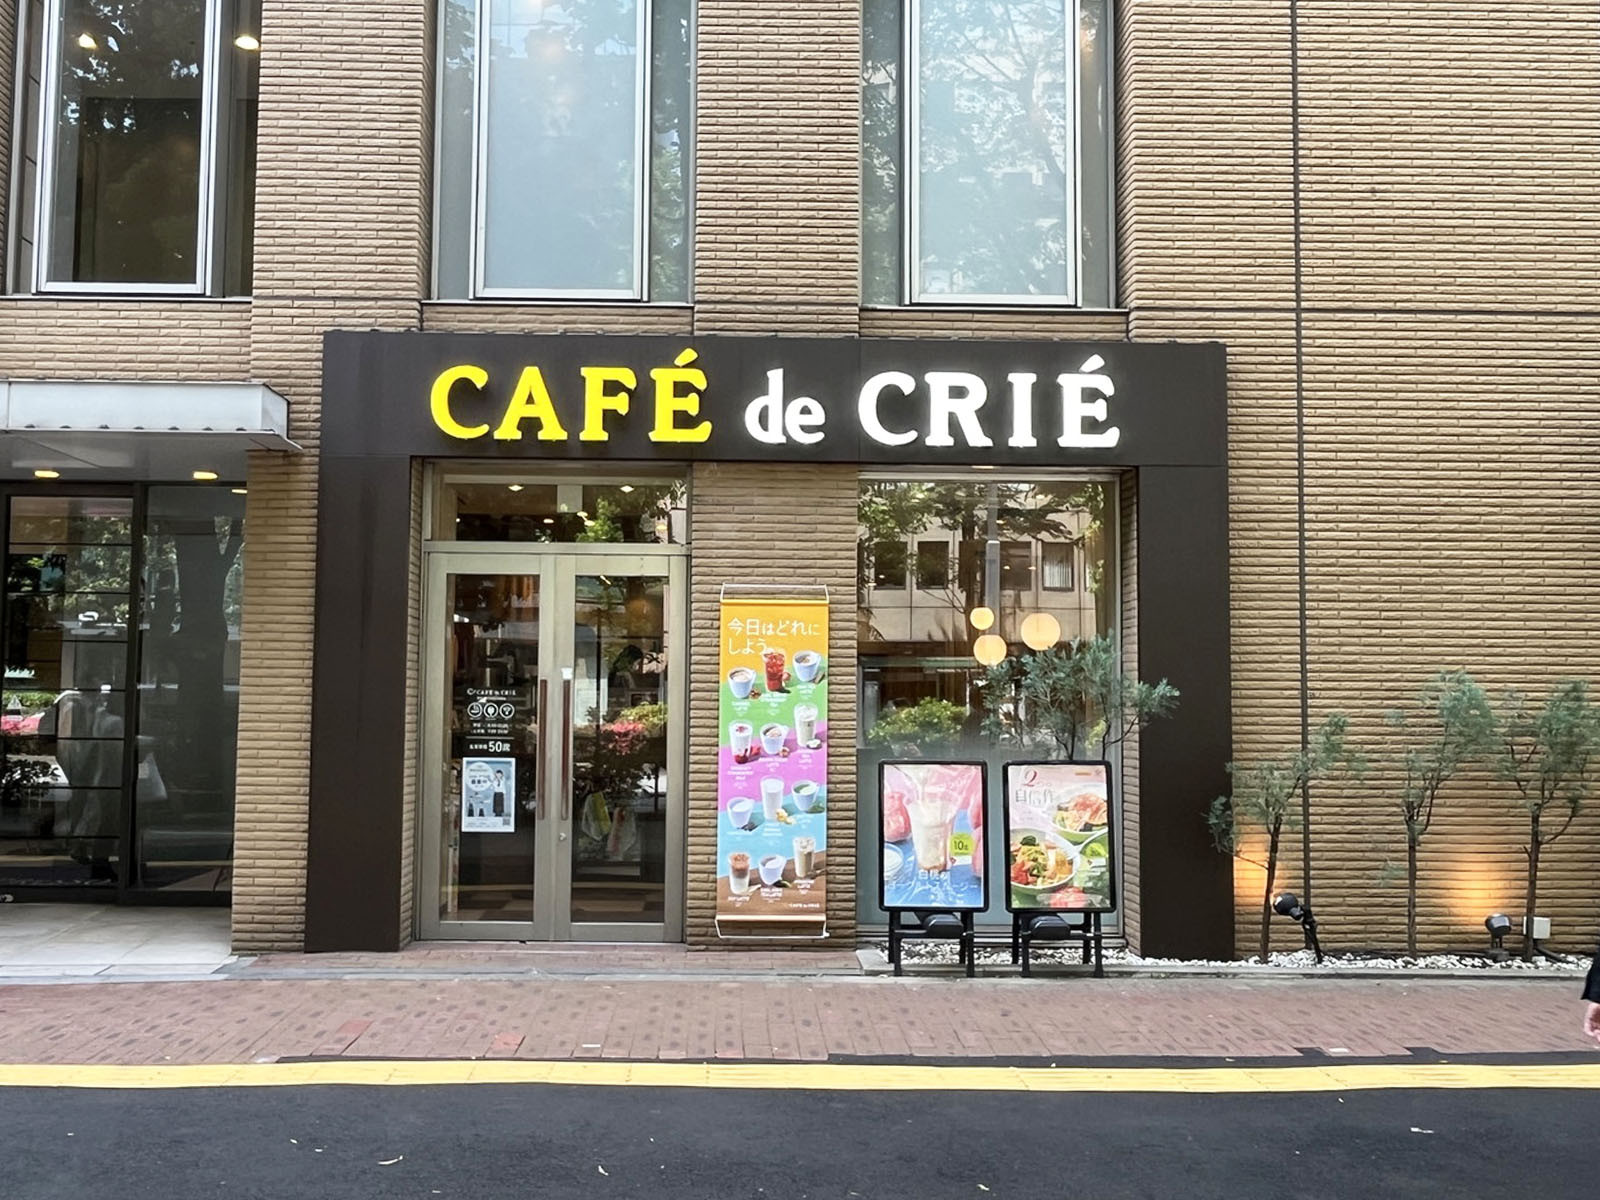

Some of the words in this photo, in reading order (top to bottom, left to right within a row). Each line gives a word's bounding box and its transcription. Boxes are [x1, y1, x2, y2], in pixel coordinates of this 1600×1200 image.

[430, 347, 712, 442] CAFÉ
[745, 368, 825, 444] de
[858, 354, 1120, 448] CRIÉ
[728, 616, 820, 636] 今日はどれに
